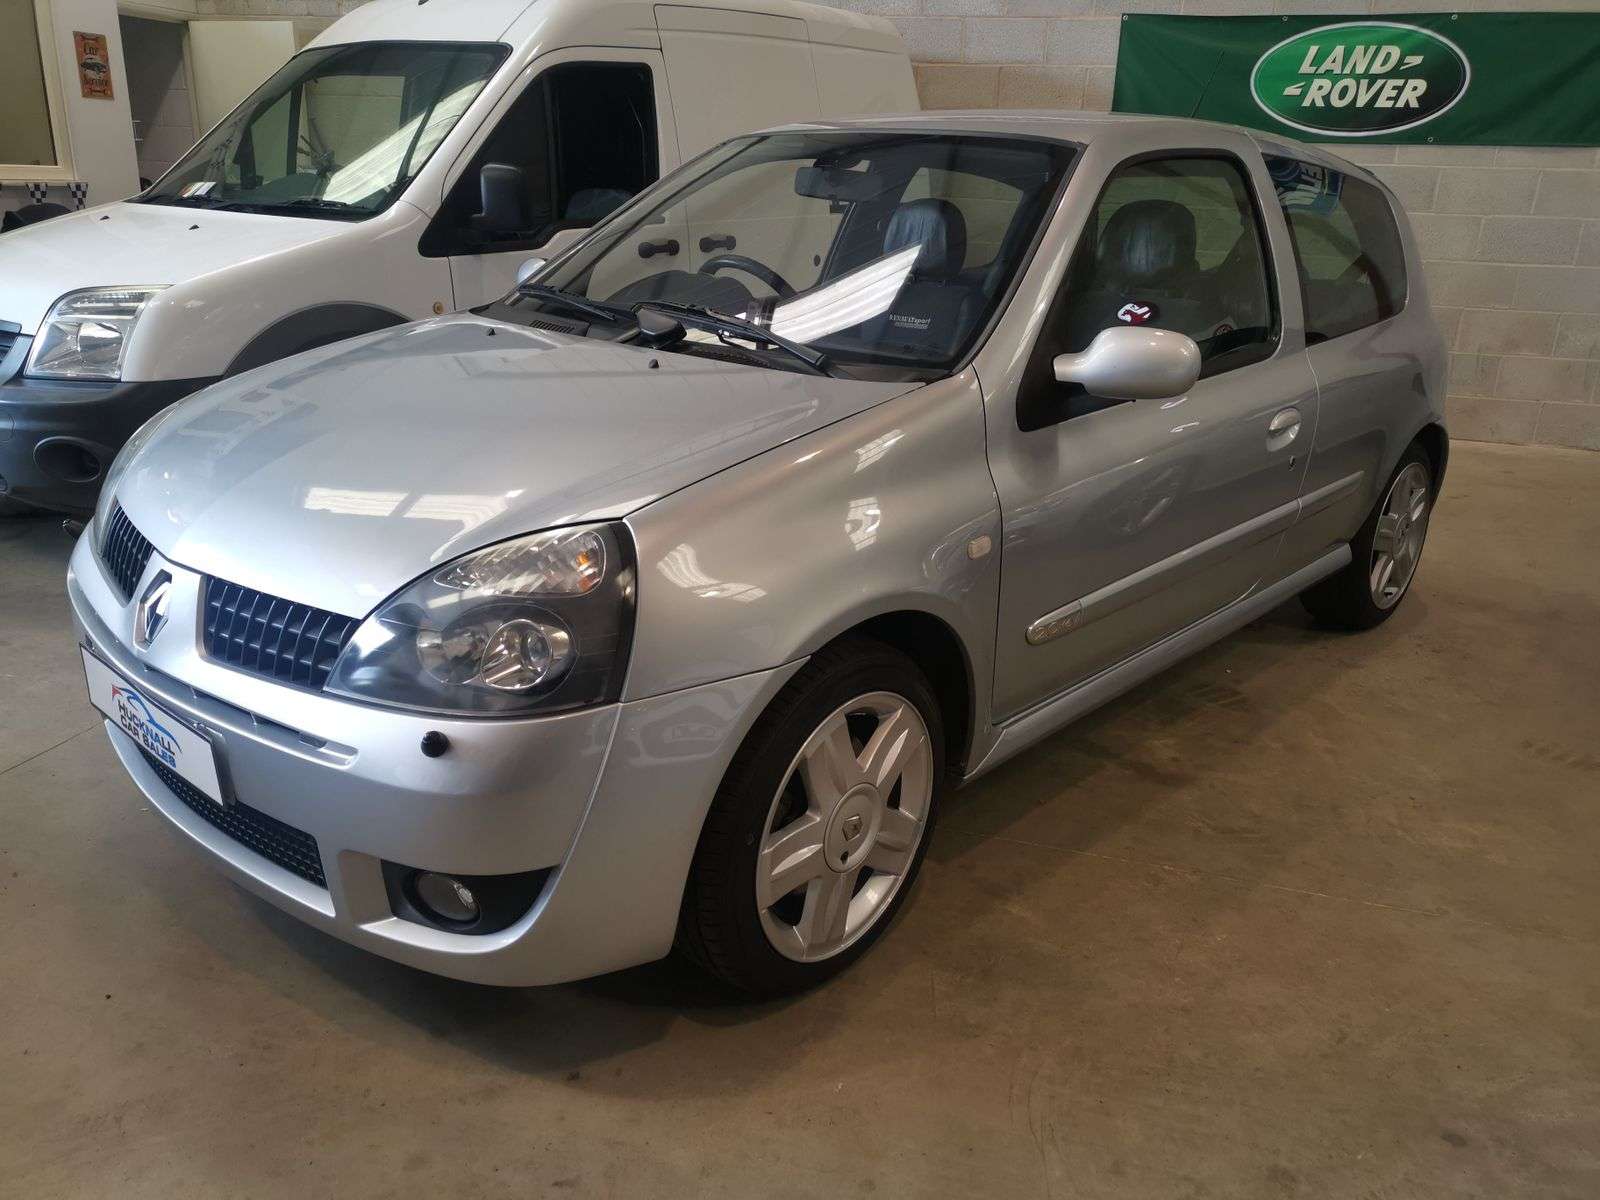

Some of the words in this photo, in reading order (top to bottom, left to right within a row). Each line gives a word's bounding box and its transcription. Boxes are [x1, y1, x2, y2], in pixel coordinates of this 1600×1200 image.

[1298, 45, 1400, 74] LAND
[1301, 79, 1427, 108] ROVER
[117, 698, 176, 756] HUCKNALL
[120, 714, 140, 739] CAR
